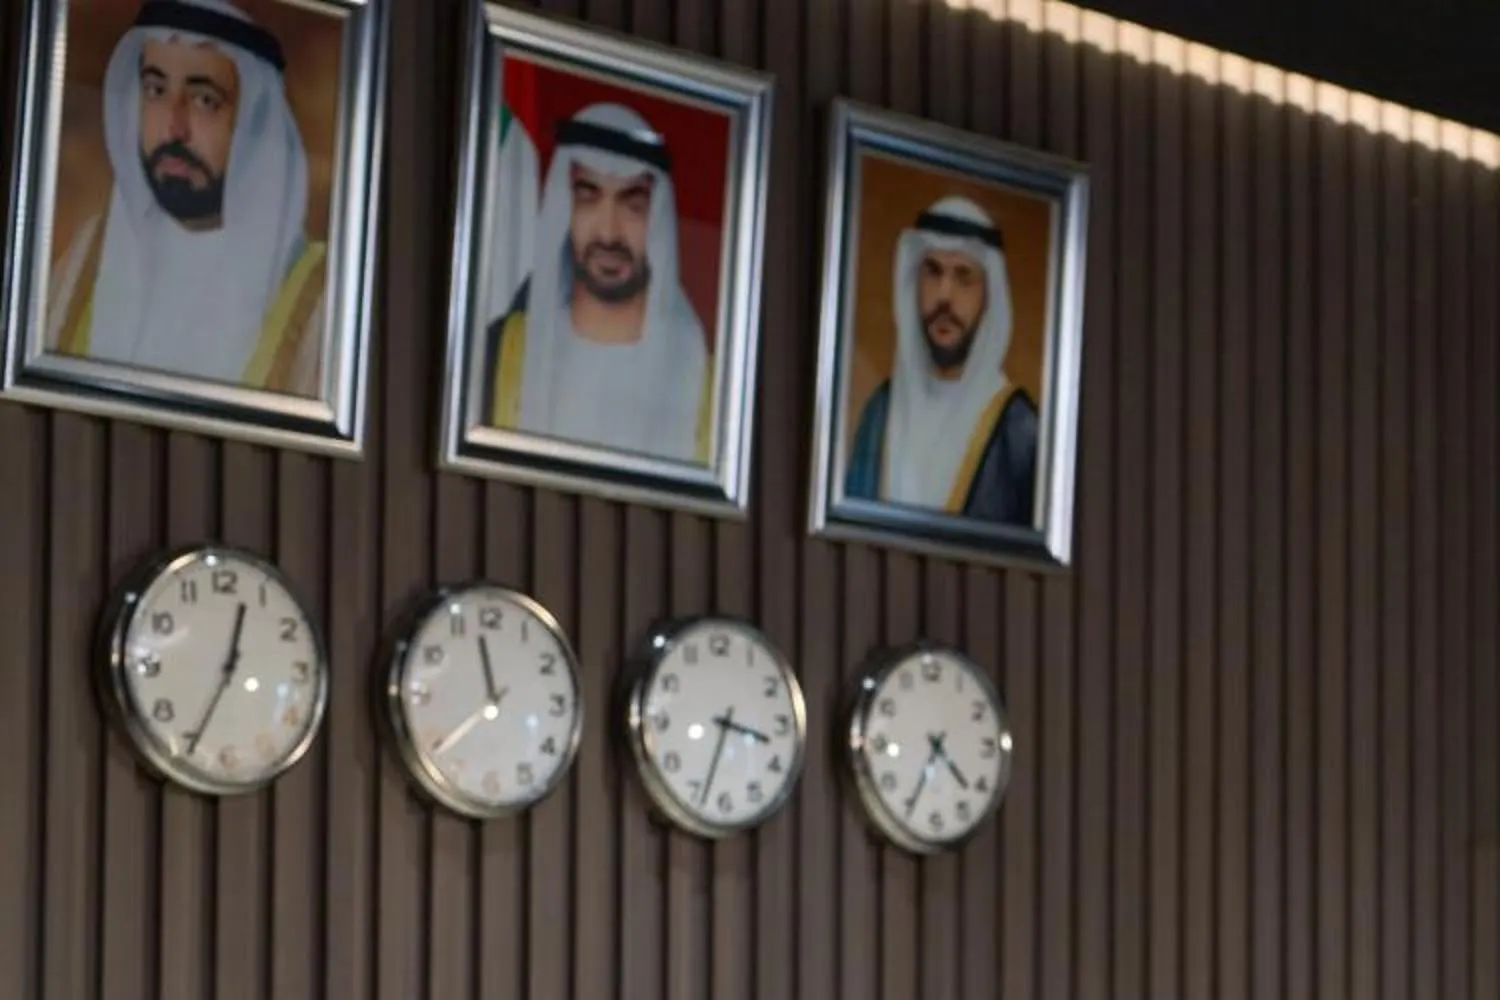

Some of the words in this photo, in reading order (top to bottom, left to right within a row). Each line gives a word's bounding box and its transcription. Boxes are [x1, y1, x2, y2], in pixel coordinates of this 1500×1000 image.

[181, 580, 197, 604] 11
[211, 570, 238, 593] 12
[259, 585, 266, 607] 1
[152, 611, 174, 635] 10
[451, 616, 465, 637] 11
[479, 607, 502, 629] 12
[279, 617, 297, 642] 2
[521, 620, 528, 642] 1
[709, 634, 730, 657] 12
[292, 661, 309, 683] 3
[540, 653, 555, 676] 2
[921, 661, 942, 683] 12
[764, 676, 778, 697] 2
[153, 698, 174, 722] 8
[549, 694, 565, 717] 3
[971, 701, 986, 721] 2
[774, 714, 788, 735] 3
[182, 733, 199, 755] 7
[540, 737, 555, 754] 4
[980, 737, 995, 759] 3
[516, 762, 533, 785] 5
[767, 754, 781, 773] 4
[686, 780, 701, 800] 7
[746, 781, 762, 802] 5
[975, 775, 988, 793] 4
[718, 792, 734, 813] 6
